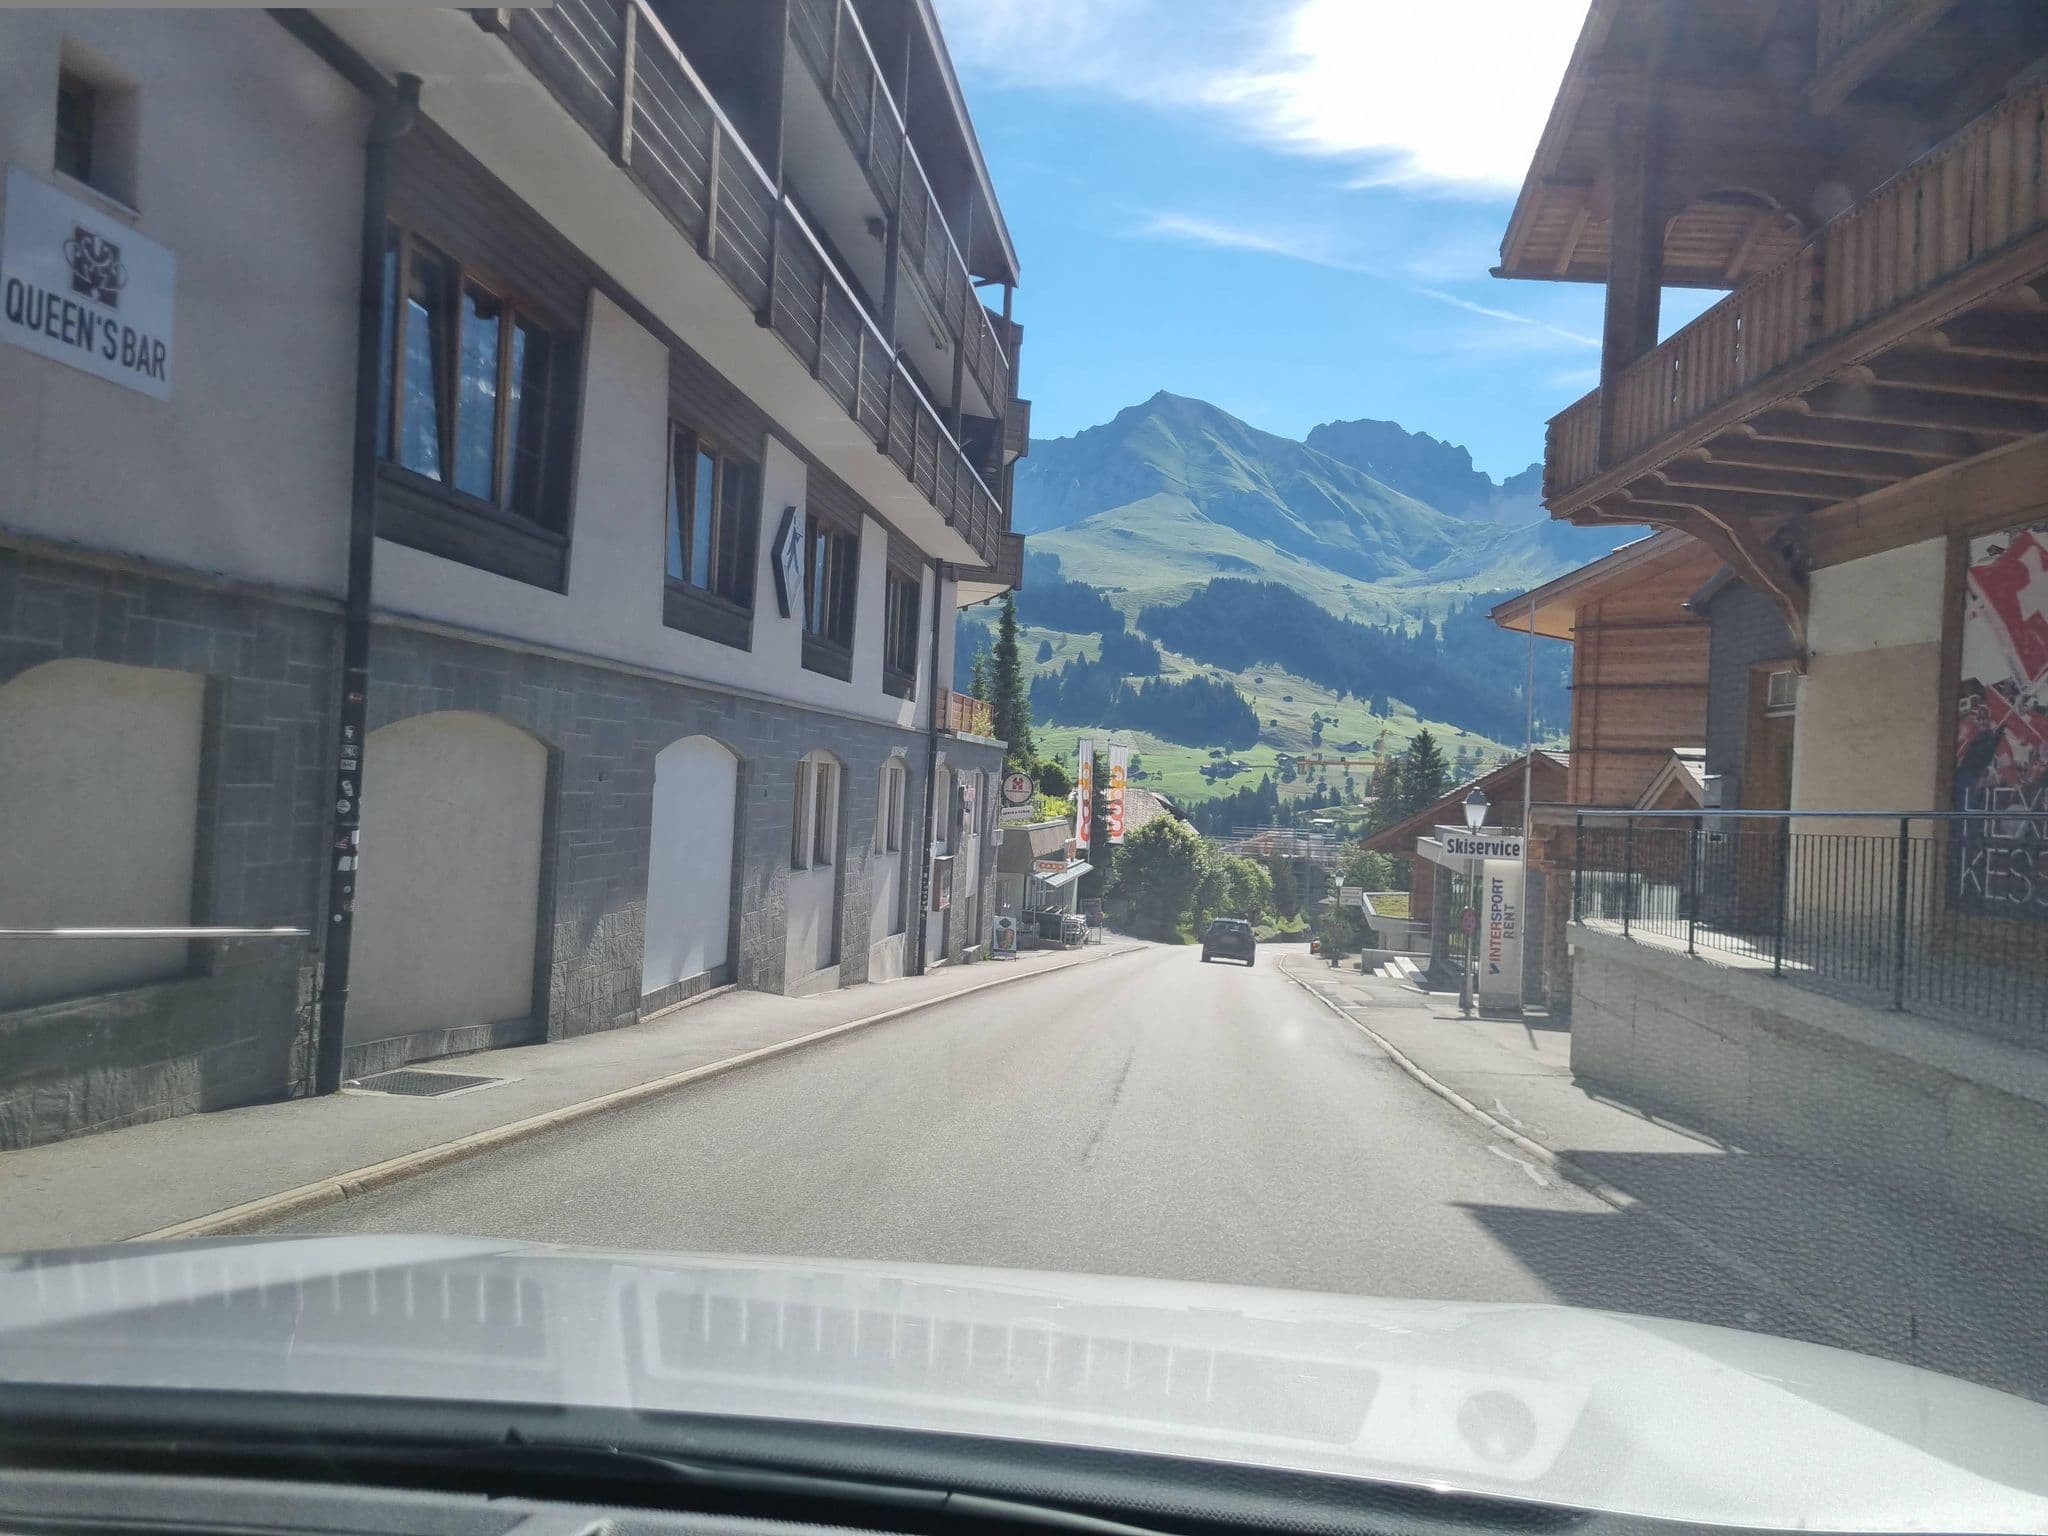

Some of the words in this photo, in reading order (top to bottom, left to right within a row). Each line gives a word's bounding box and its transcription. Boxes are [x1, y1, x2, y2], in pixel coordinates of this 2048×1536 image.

[5, 277, 118, 361] QUEEN'S
[121, 325, 167, 381] BAR
[1446, 838, 1521, 857] Skiservice
[1489, 876, 1504, 962] INTERSPORT
[1503, 903, 1516, 940] RENT
